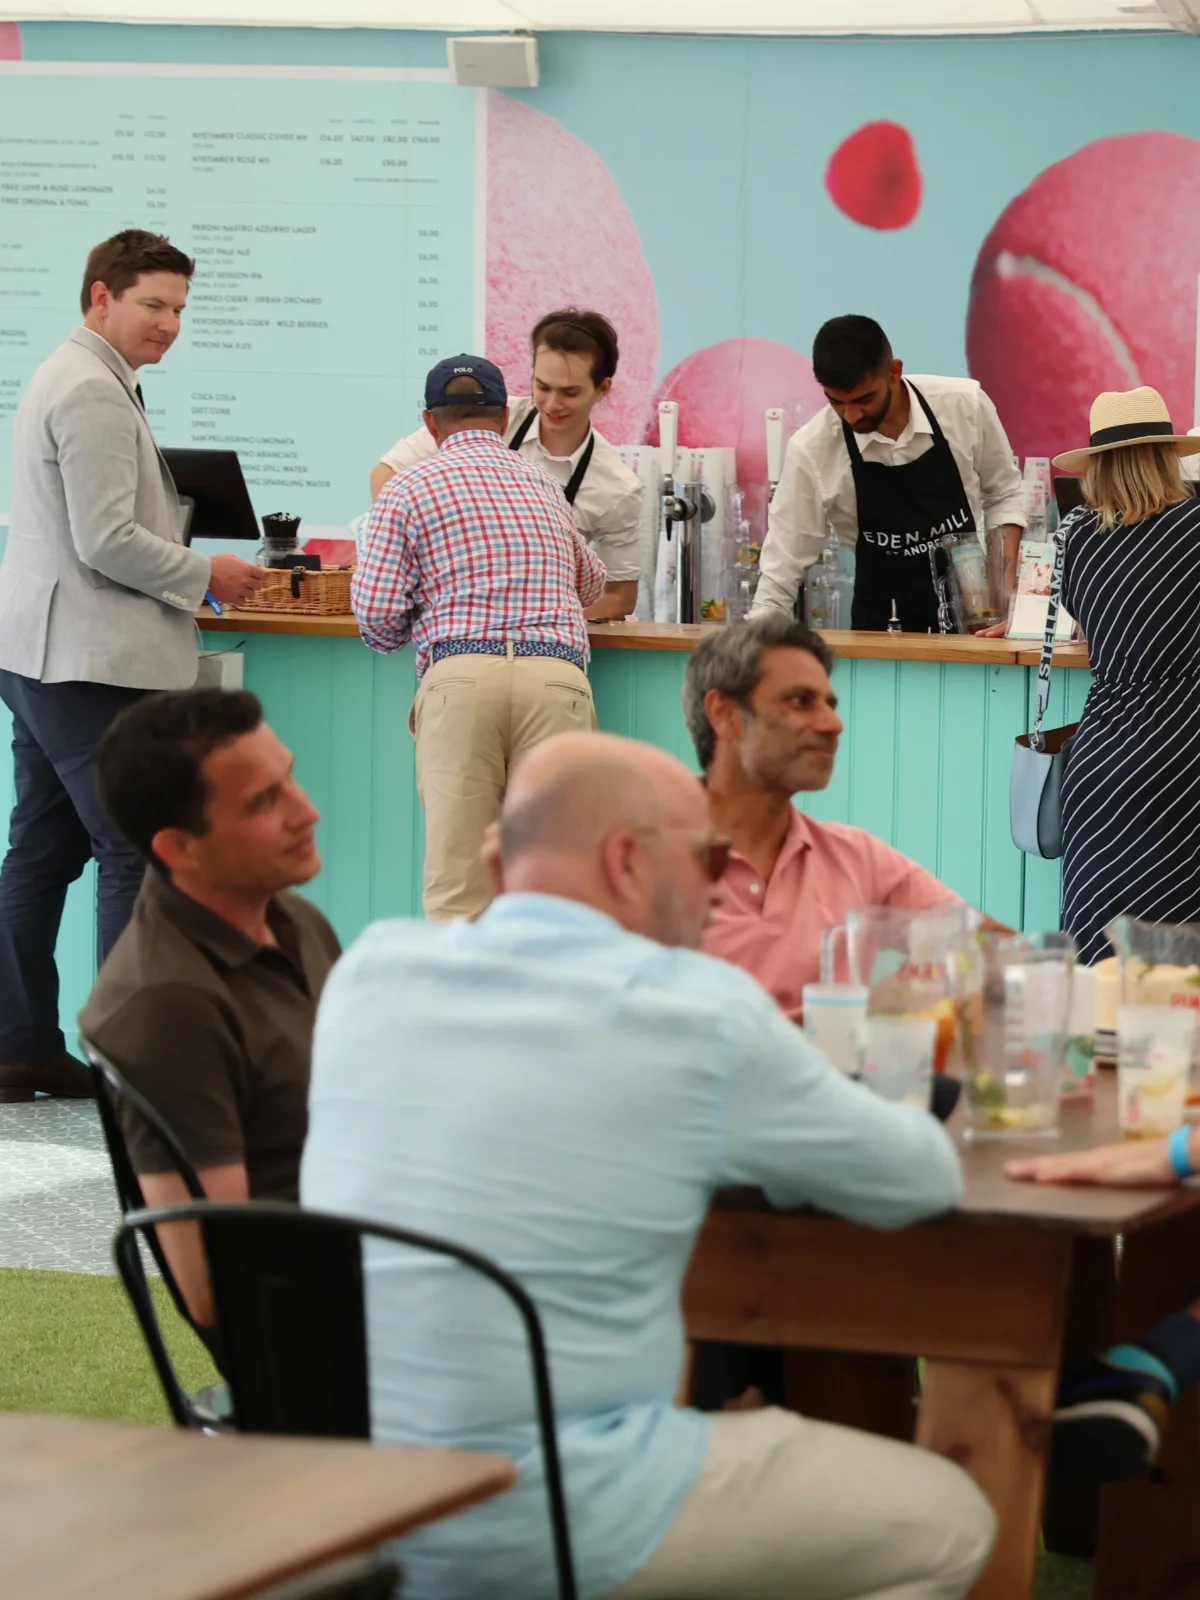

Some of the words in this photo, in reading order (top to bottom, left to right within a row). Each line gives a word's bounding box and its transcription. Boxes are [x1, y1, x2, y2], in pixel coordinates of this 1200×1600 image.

[236, 132, 268, 141] CLASSIC
[291, 226, 317, 234] LAGER
[224, 294, 249, 303] CIDER
[245, 319, 270, 328] CIDER
[296, 321, 329, 330] BERRIES
[453, 366, 474, 374] POLO
